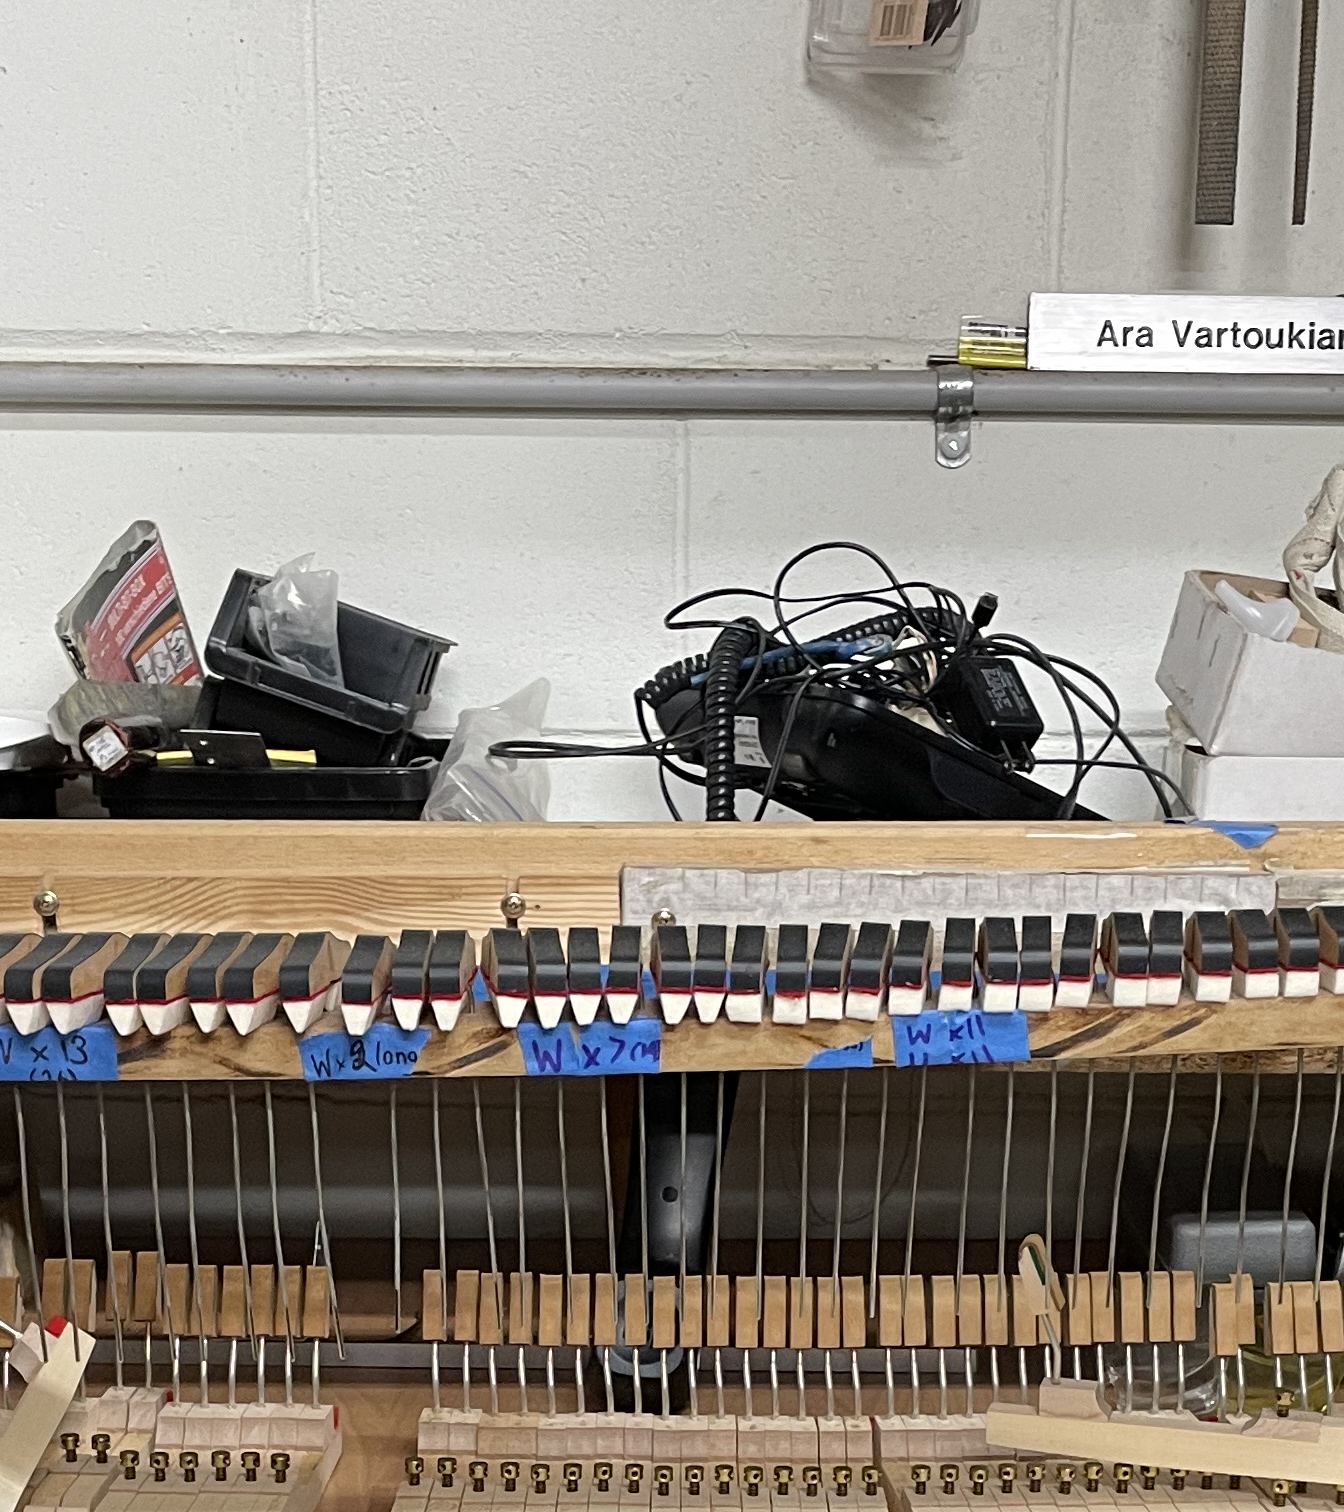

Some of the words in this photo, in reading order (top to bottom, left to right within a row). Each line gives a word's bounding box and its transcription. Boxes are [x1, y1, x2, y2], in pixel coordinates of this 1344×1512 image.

[1096, 319, 1154, 348] Ara
[907, 1023, 932, 1045] W
[30, 1045, 50, 1063] x
[60, 1035, 88, 1065] 13
[311, 1047, 332, 1078] W
[336, 1057, 345, 1072] x
[532, 1038, 562, 1073] W
[581, 1043, 602, 1070] x
